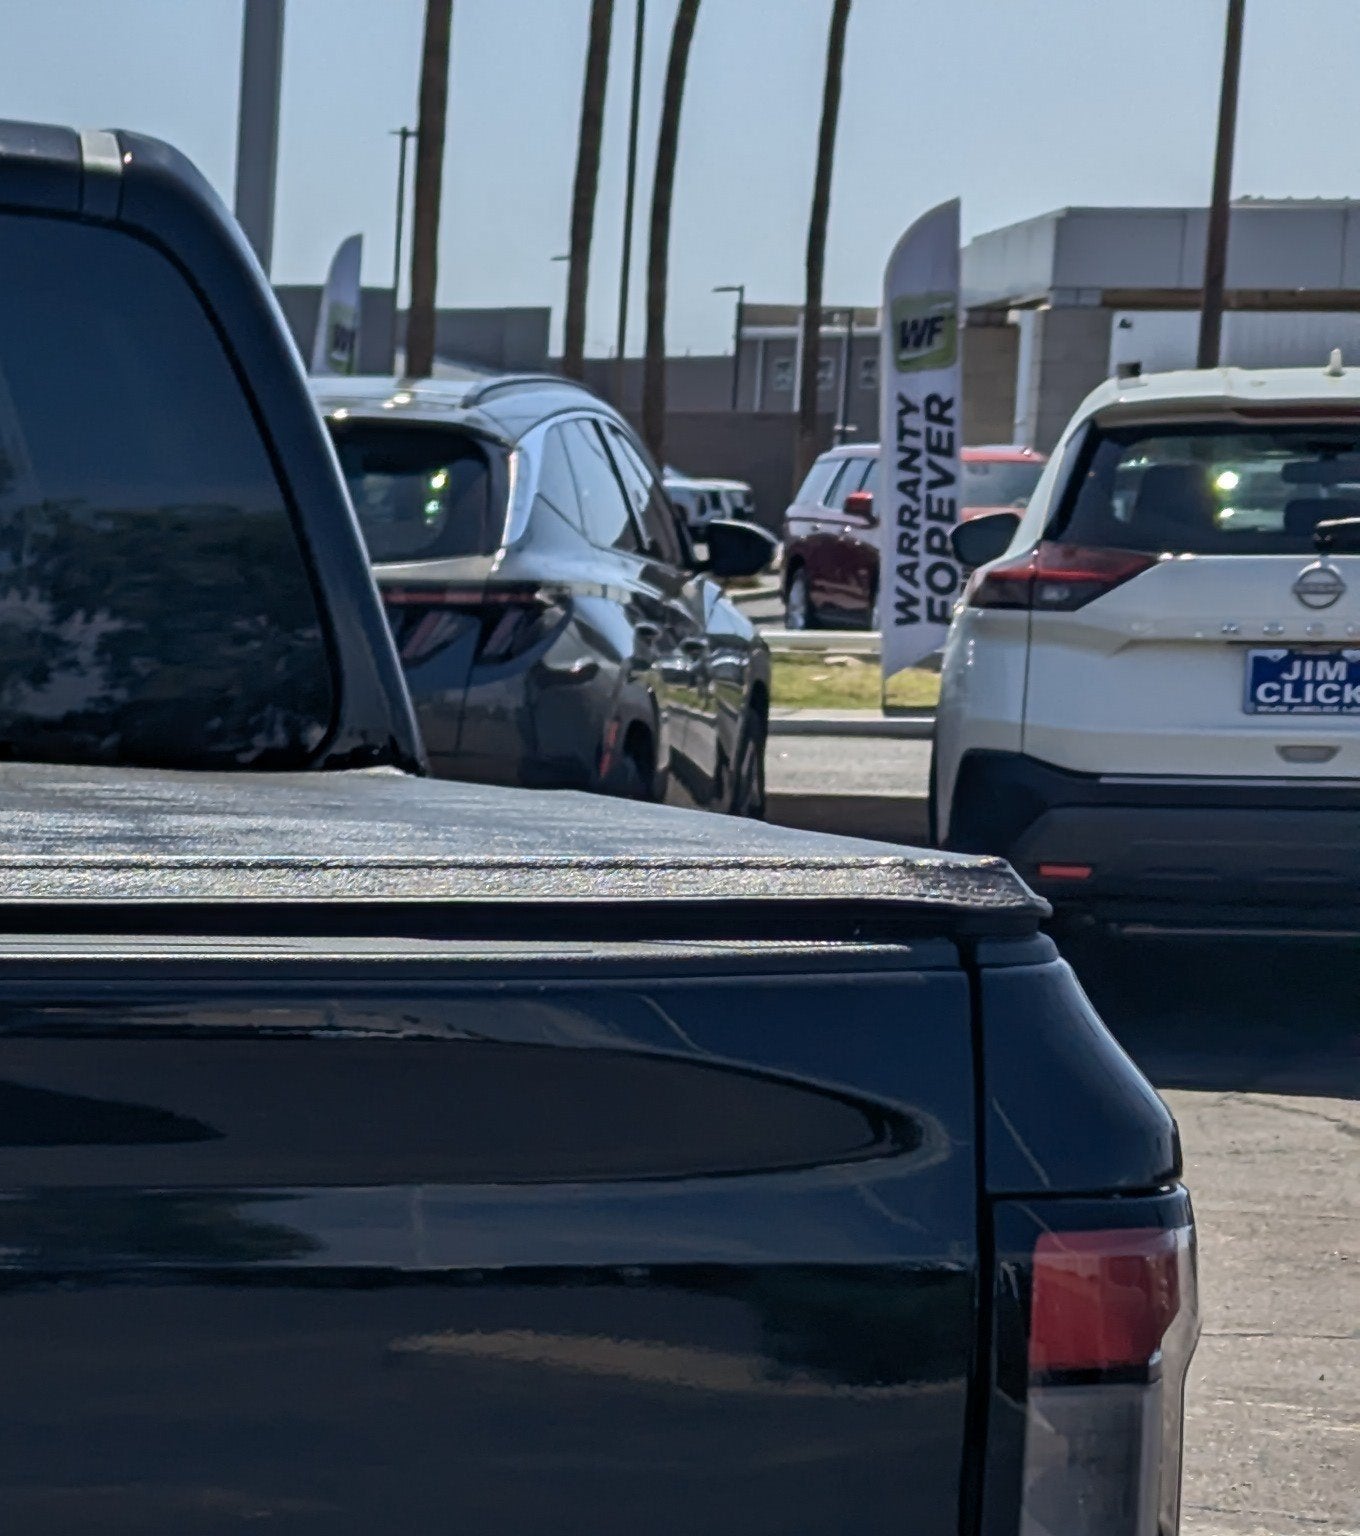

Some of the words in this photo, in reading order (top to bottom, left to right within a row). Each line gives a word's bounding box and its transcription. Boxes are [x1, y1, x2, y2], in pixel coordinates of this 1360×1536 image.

[899, 316, 945, 350] WF
[894, 391, 922, 627] WARRANTY
[924, 392, 959, 626] FOREVER
[1280, 660, 1347, 681] JIM
[1256, 682, 1360, 703] CLICK
